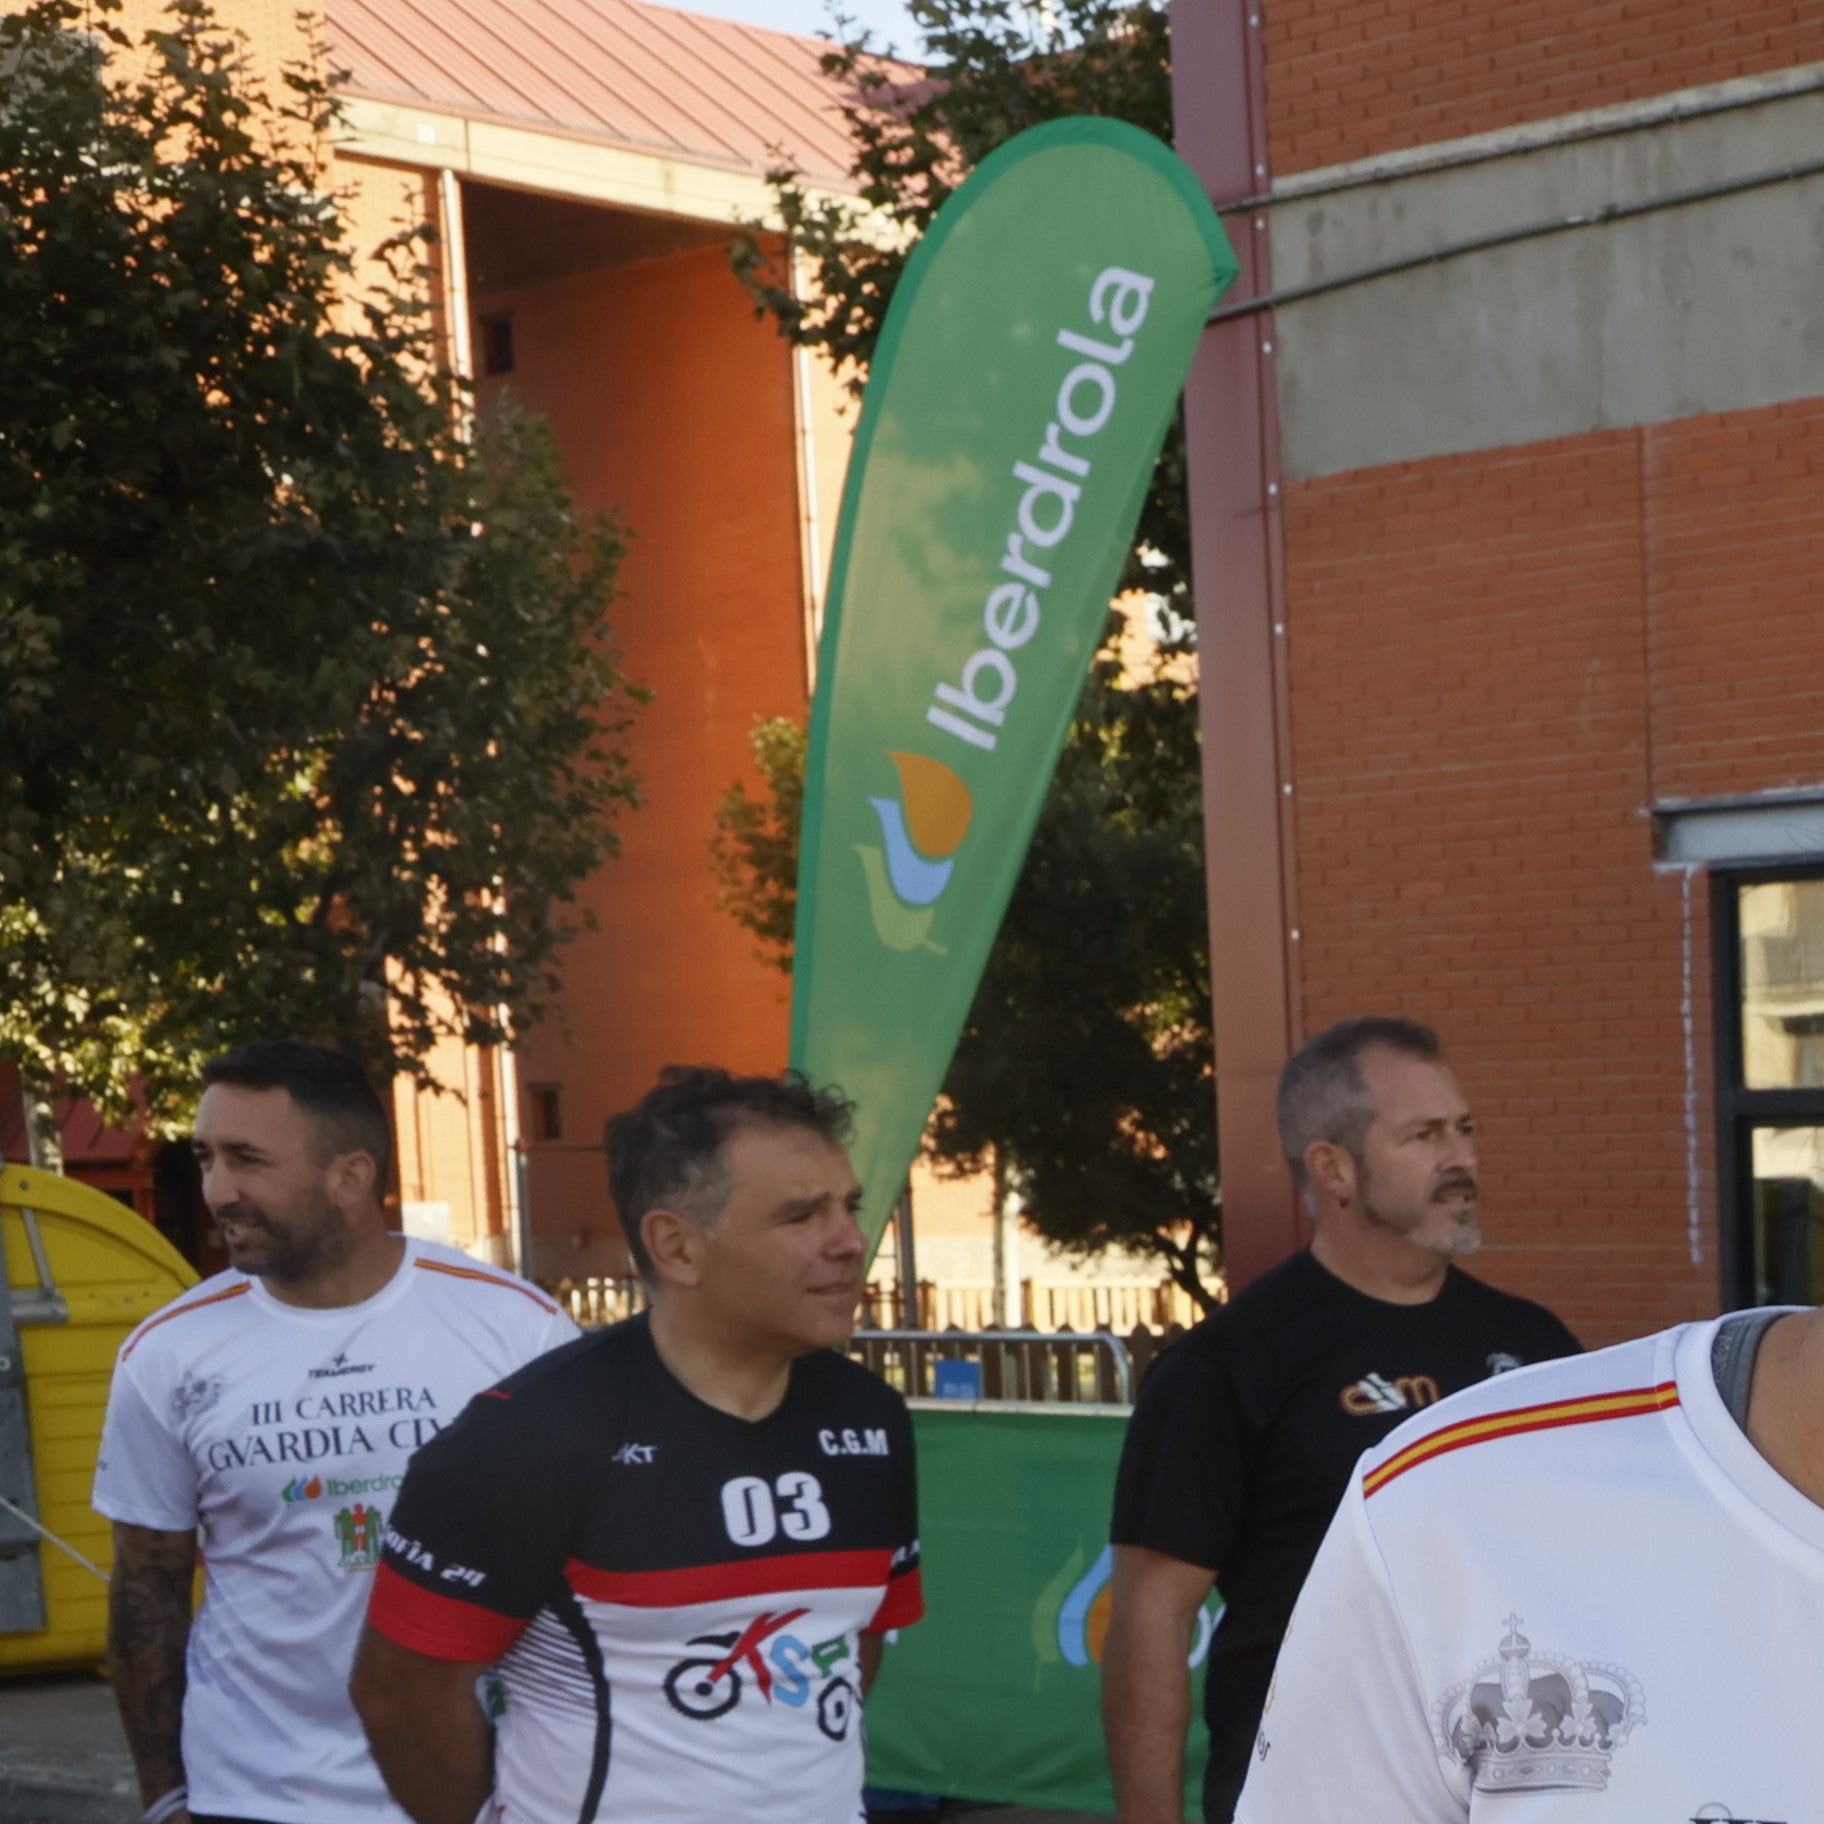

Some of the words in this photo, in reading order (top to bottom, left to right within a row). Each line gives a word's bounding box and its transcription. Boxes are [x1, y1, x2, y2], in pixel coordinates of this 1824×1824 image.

[926, 265, 1155, 750] Iberdrola
[251, 1401, 283, 1427] III
[296, 1387, 438, 1421] CARRERA
[207, 1425, 376, 1472] GVARDIA
[327, 1473, 403, 1497] Iberdro
[721, 1471, 831, 1547] 03
